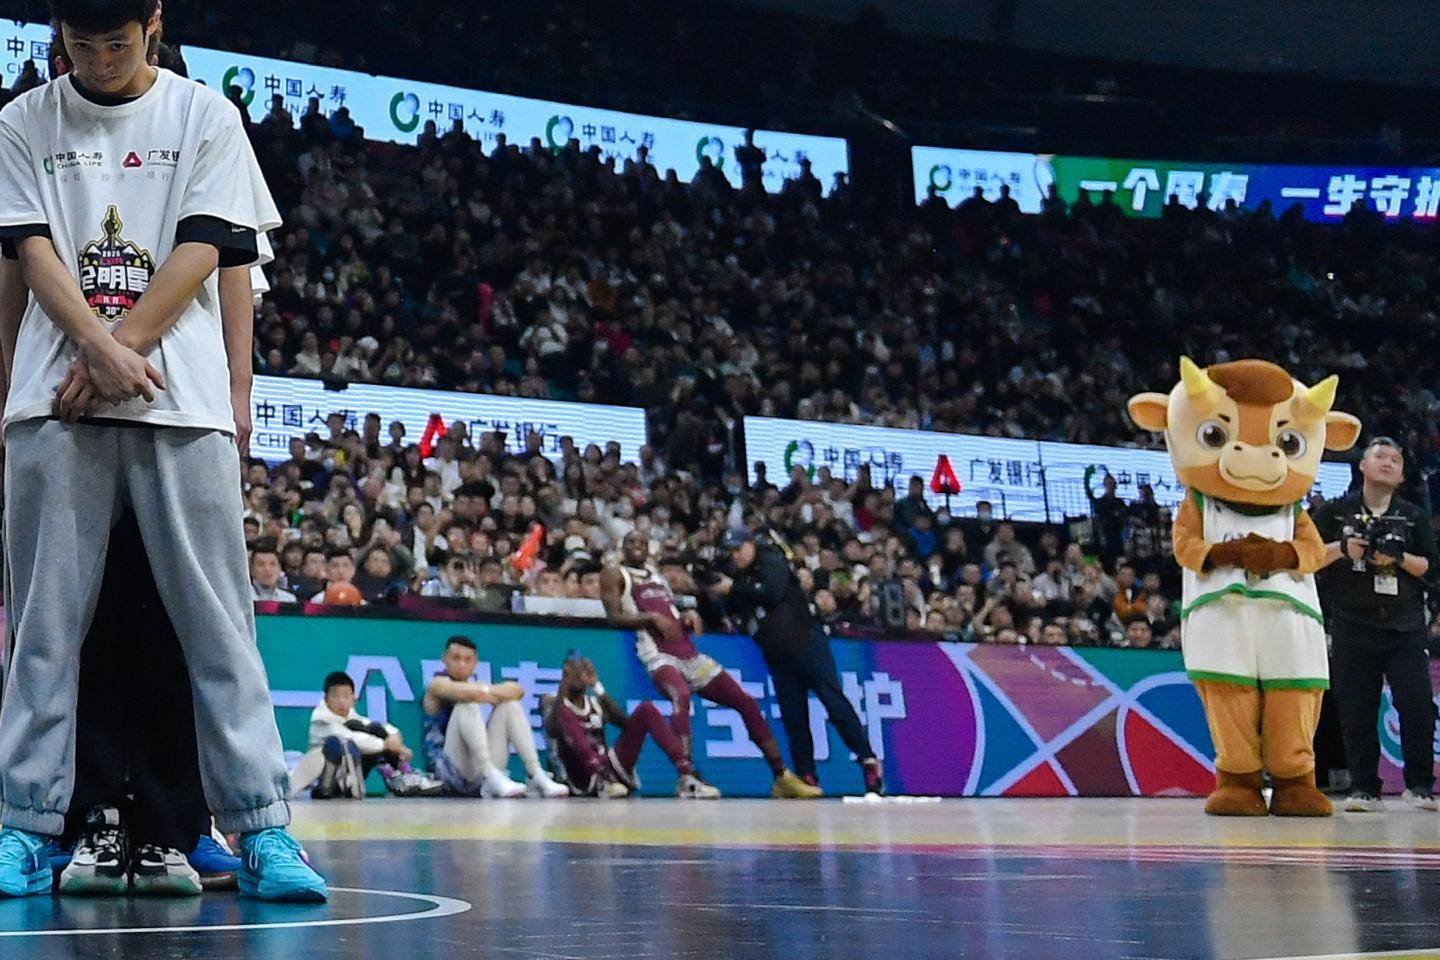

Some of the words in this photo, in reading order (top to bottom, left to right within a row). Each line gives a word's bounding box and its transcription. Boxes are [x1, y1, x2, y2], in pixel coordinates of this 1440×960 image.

[264, 74, 348, 106] 中国人寿
[428, 99, 506, 129] 中国人寿
[56, 151, 103, 162] 中国人寿
[56, 161, 81, 169] CHINA
[256, 399, 359, 431] 中国人寿
[1117, 470, 1183, 490] 中国人
